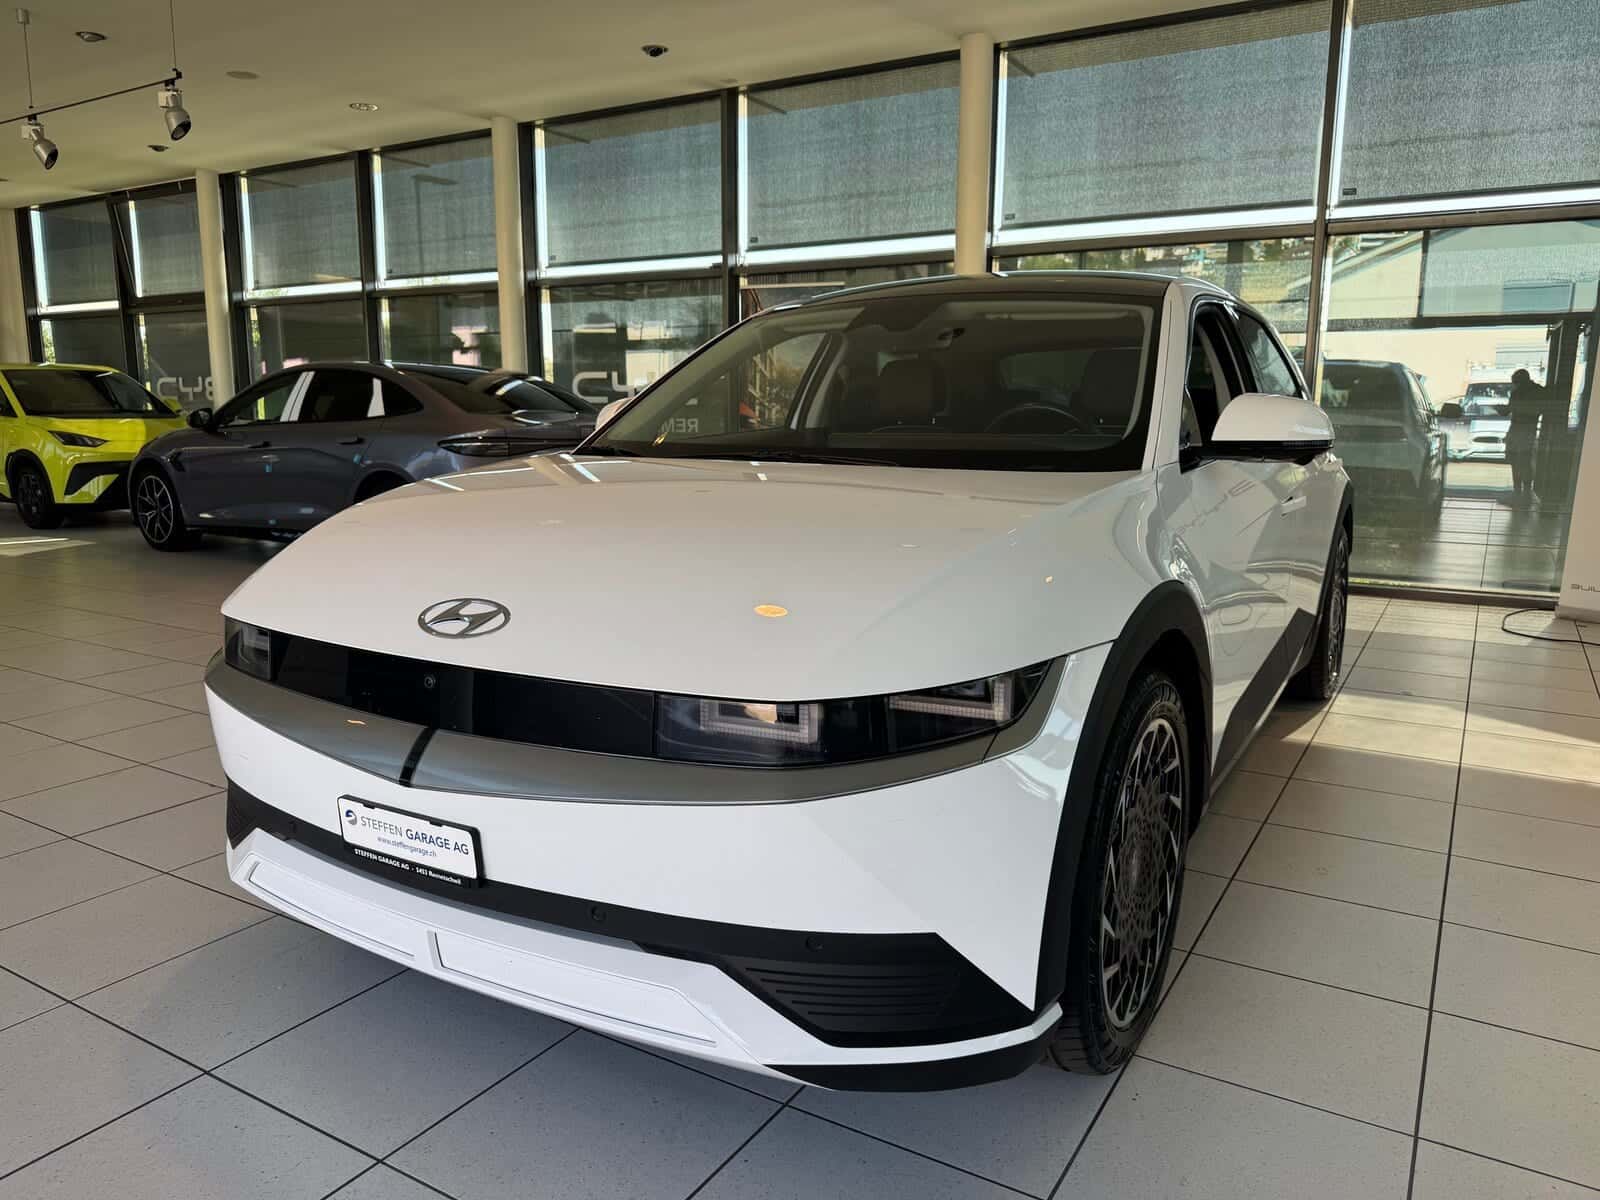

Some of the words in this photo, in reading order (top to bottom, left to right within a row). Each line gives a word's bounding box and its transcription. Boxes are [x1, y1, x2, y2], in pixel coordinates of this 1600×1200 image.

[360, 815, 403, 836] STEFFEN
[405, 828, 451, 850] GARAGE
[453, 842, 469, 855] AG
[354, 848, 378, 861] STEFFEN
[378, 856, 401, 868] GARAGE
[401, 863, 410, 871] AG
